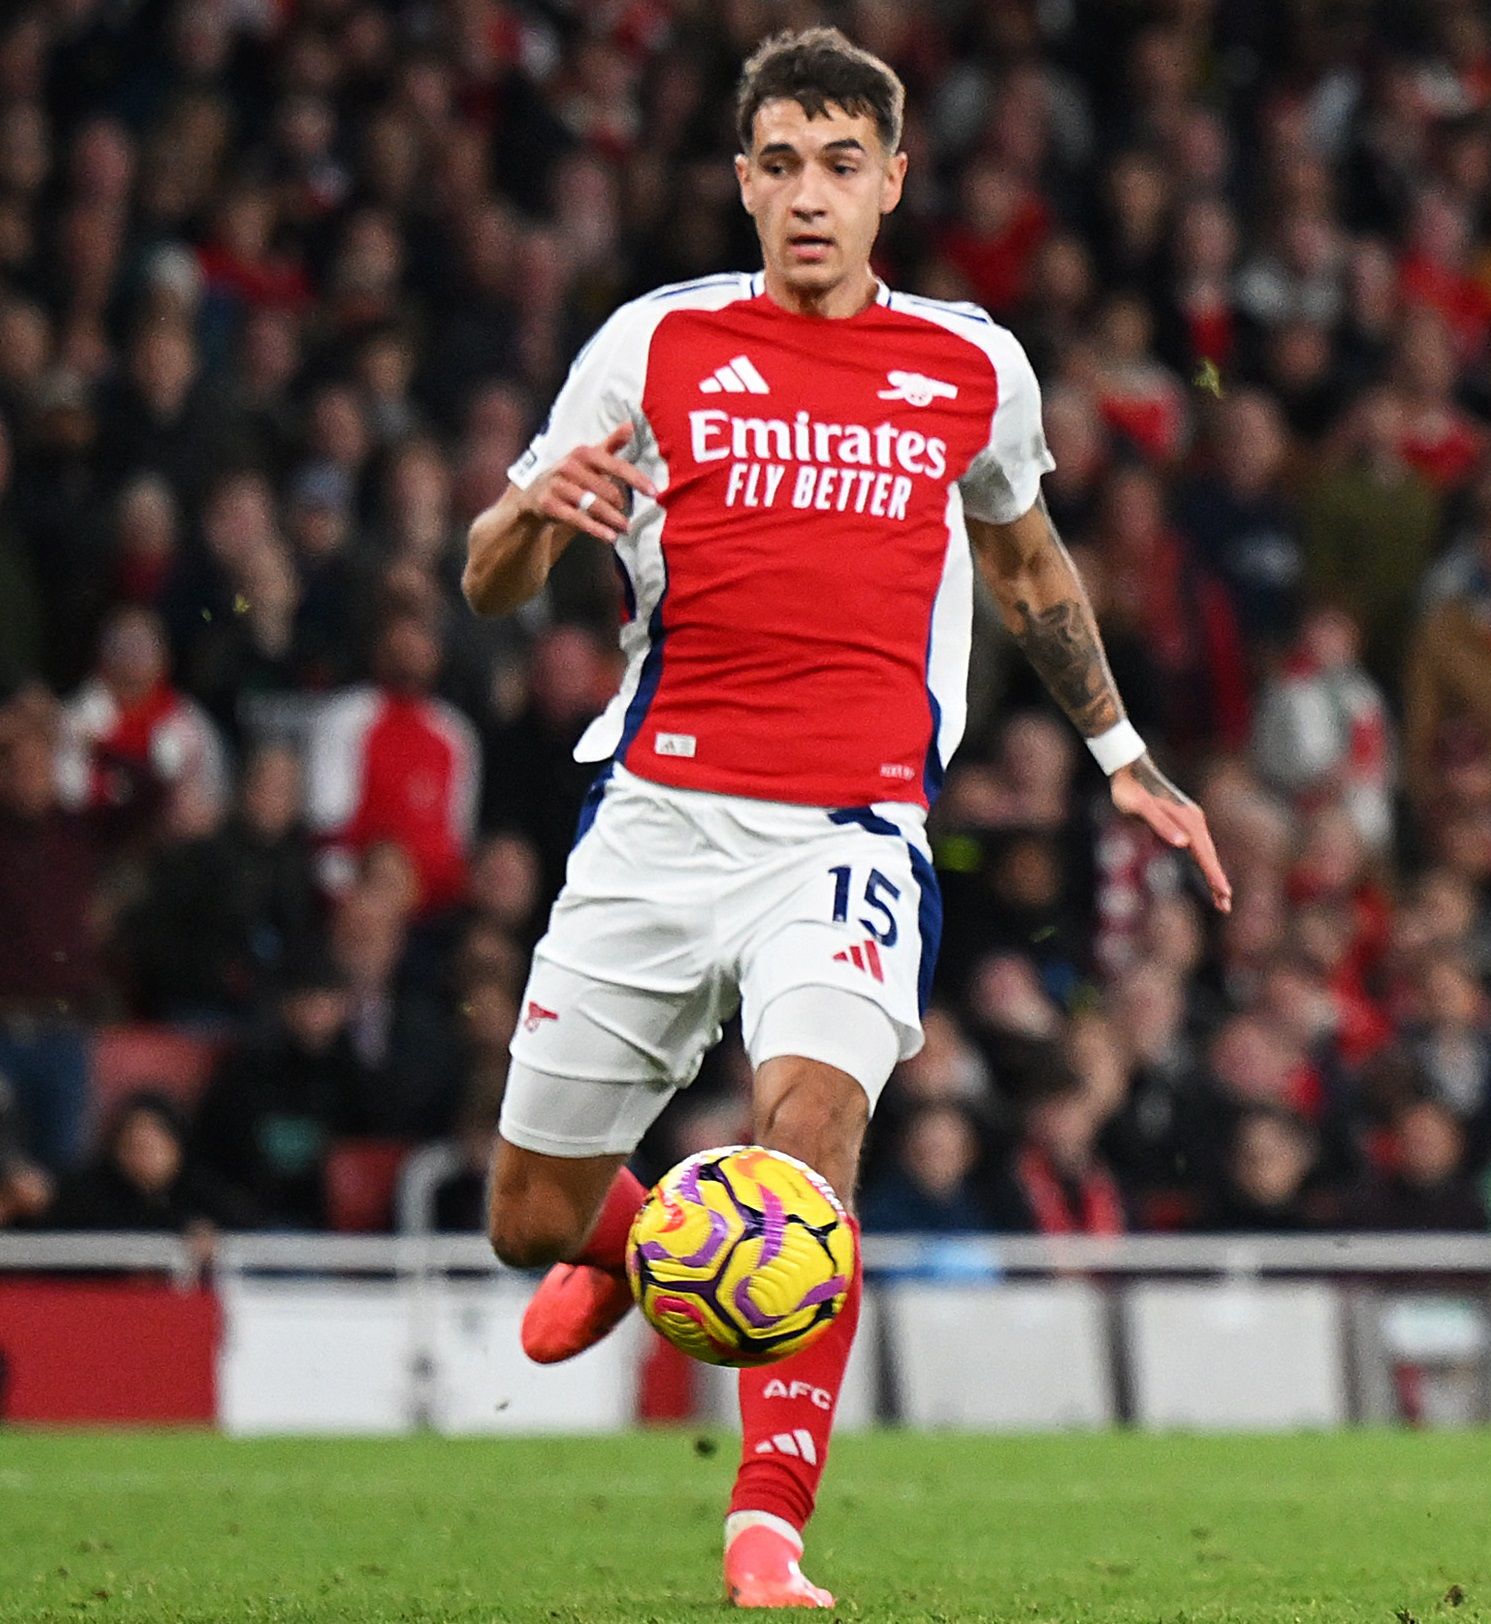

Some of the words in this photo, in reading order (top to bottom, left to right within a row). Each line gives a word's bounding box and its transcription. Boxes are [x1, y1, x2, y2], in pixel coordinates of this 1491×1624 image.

[688, 409, 947, 480] Emirates
[725, 462, 785, 508] FLY
[792, 465, 913, 521] BETTER
[828, 865, 901, 948] 15
[763, 1379, 832, 1411] AFC
